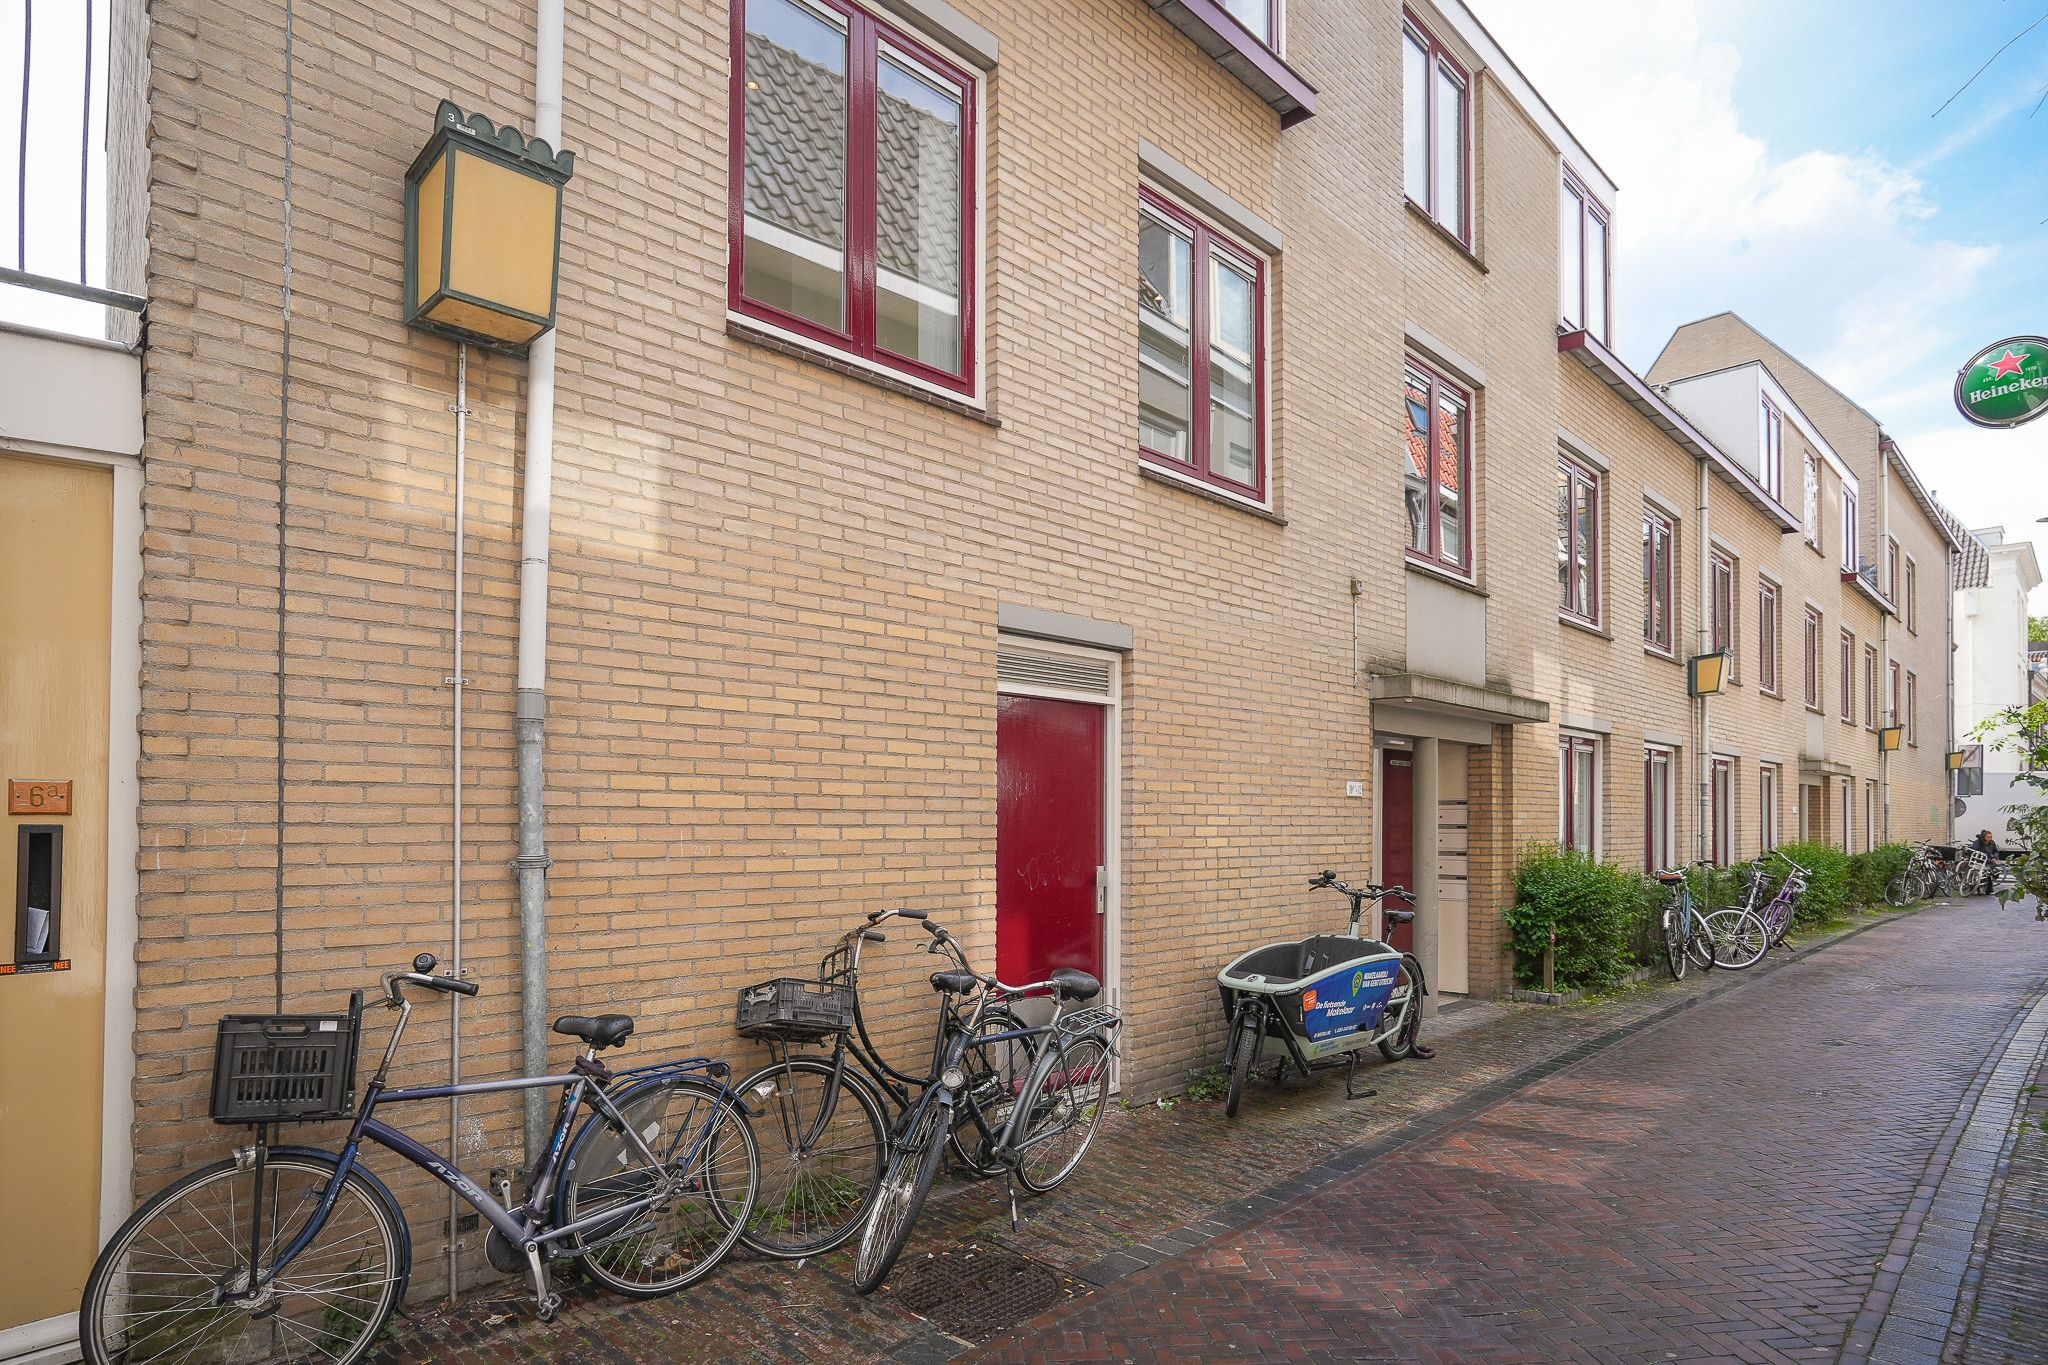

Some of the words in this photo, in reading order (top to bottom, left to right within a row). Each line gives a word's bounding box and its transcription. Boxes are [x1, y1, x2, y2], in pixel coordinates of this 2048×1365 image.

[447, 112, 455, 123] 3
[0, 965, 16, 974] NEE
[54, 960, 69, 970] NEE
[427, 1160, 483, 1203] AZOR
